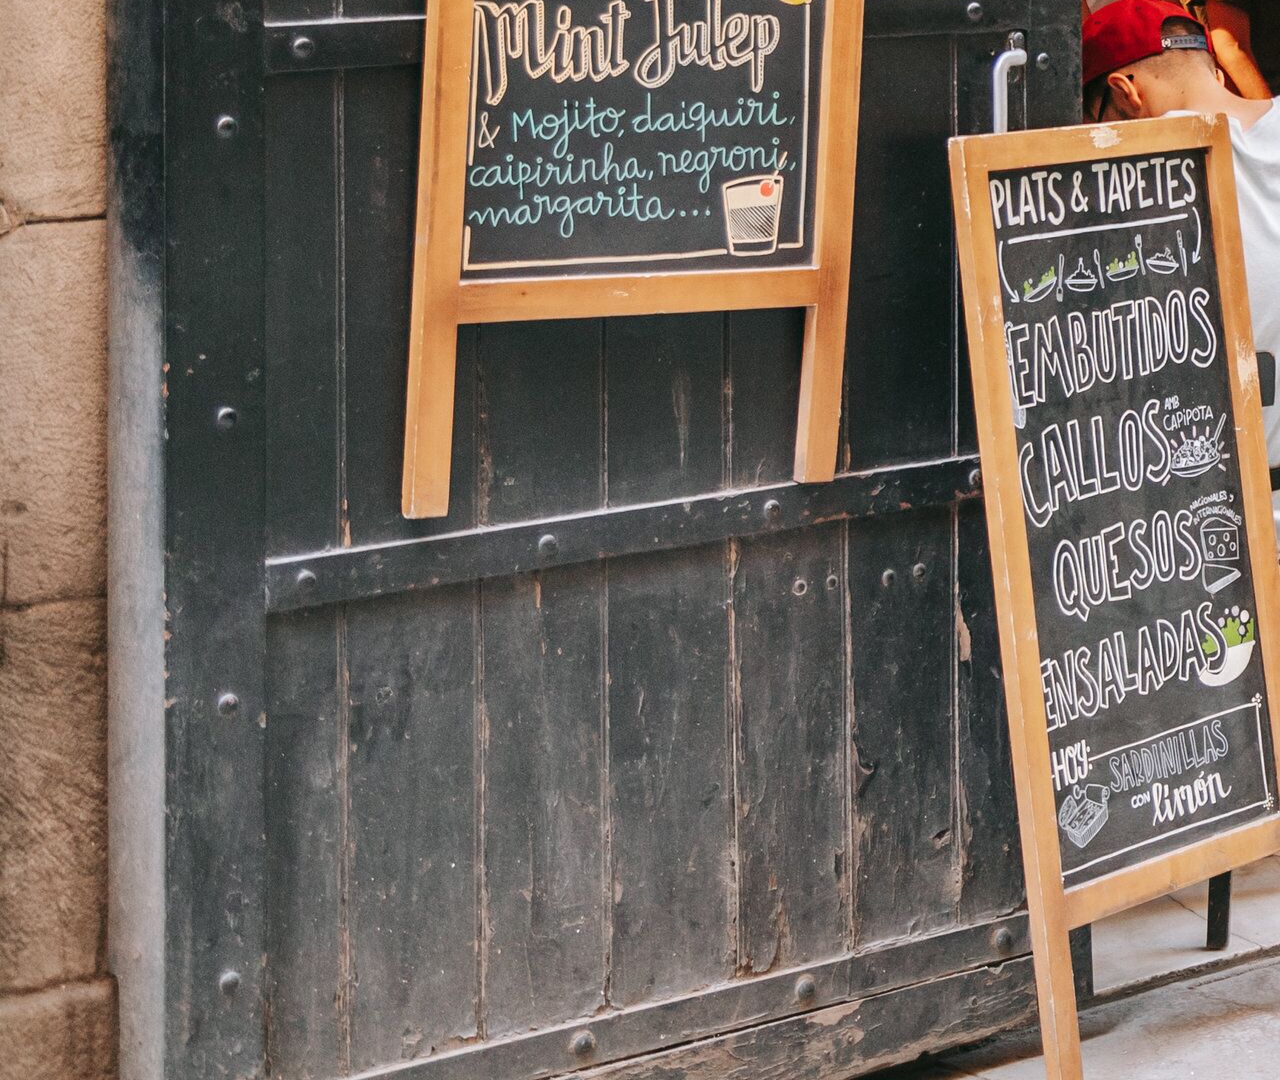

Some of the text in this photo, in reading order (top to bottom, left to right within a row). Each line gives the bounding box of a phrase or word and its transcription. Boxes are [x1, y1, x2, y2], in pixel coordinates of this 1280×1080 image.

[474, 0, 631, 105] Mint
[470, 137, 797, 199] caipirinha, negroni,
[478, 92, 796, 158] & Mojito, daiquiri,
[990, 157, 1197, 230] PLATS & TAPETES
[1007, 288, 1218, 408] EMBUTIDOS
[1164, 395, 1180, 410] AMB
[1018, 398, 1172, 528] CALLOS
[1054, 509, 1203, 621] QUESOS
[1041, 602, 1229, 732] ENSALADAS
[1109, 720, 1229, 792] SARDINILLAS
